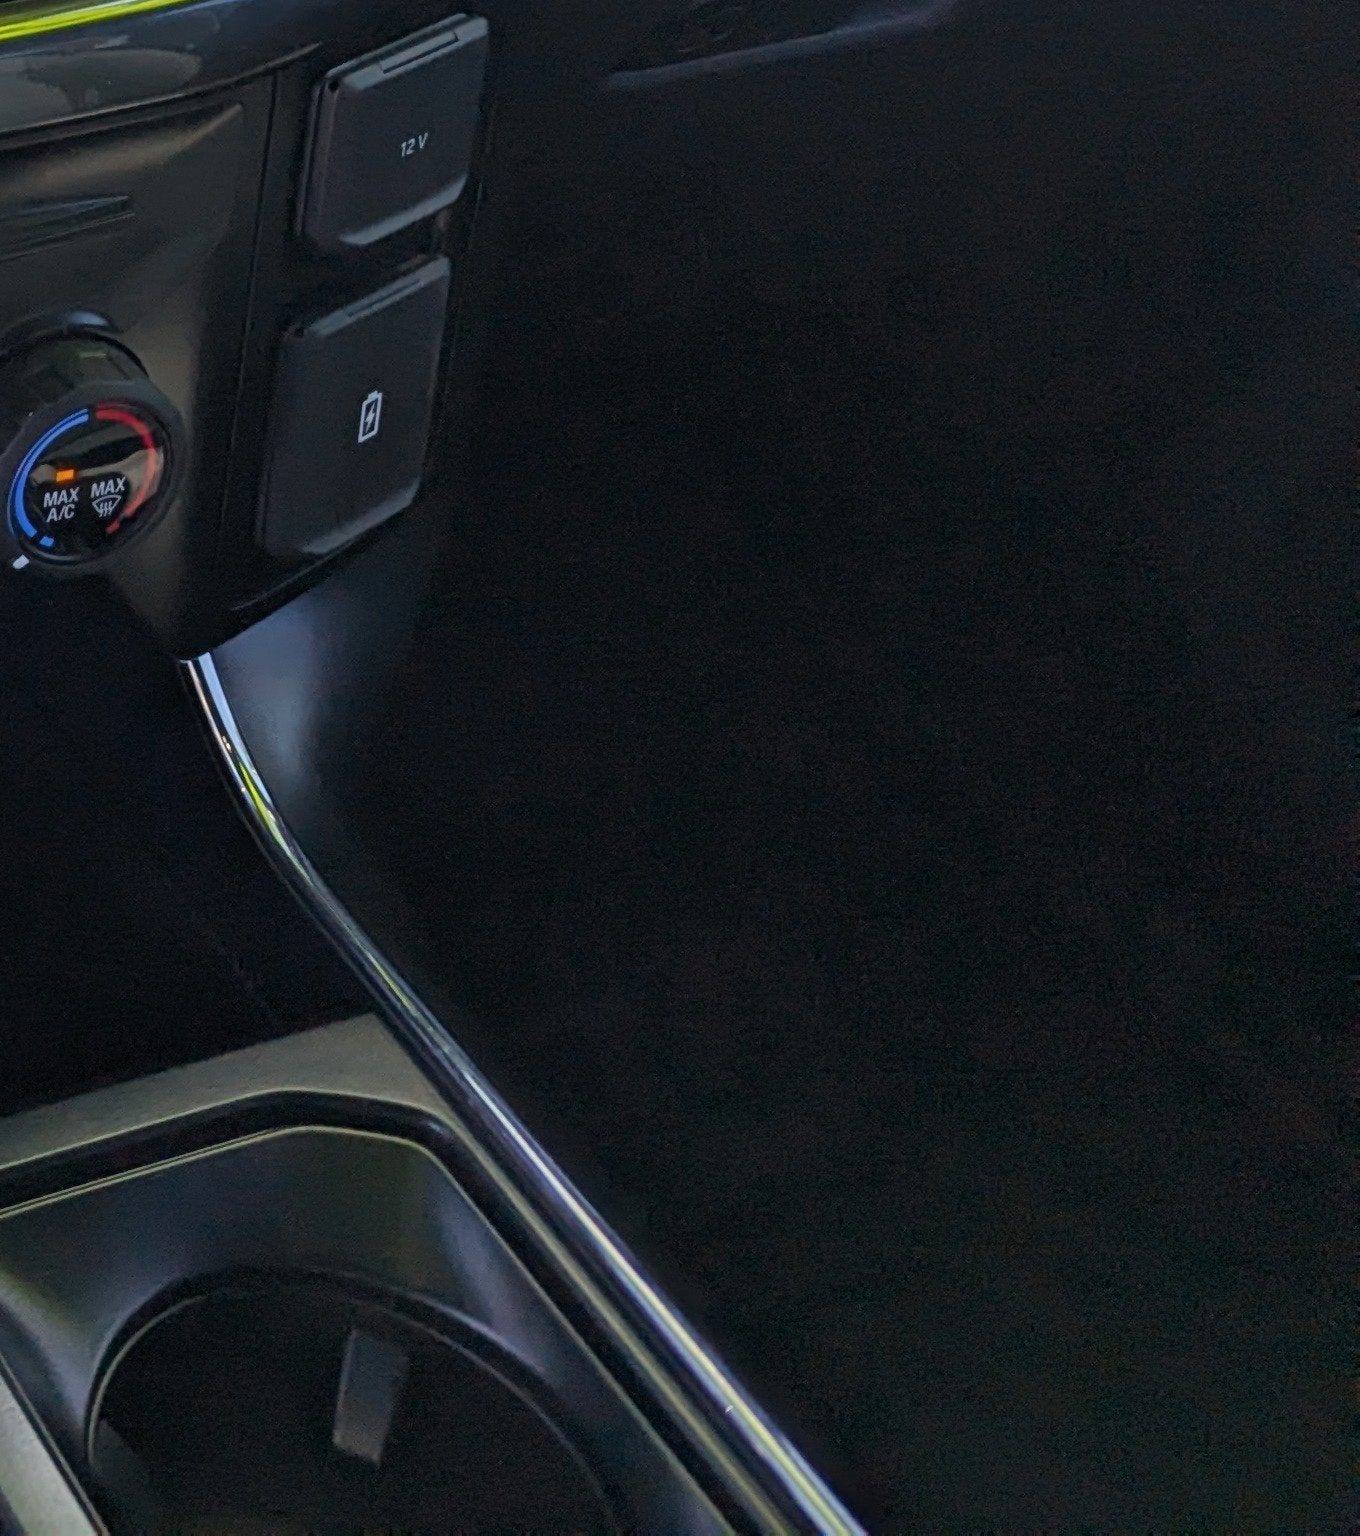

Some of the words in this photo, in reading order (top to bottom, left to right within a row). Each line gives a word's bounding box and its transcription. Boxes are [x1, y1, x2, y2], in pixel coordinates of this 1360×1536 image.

[43, 486, 80, 509] MAX
[89, 476, 127, 499] MAX
[46, 502, 76, 523] A/C
